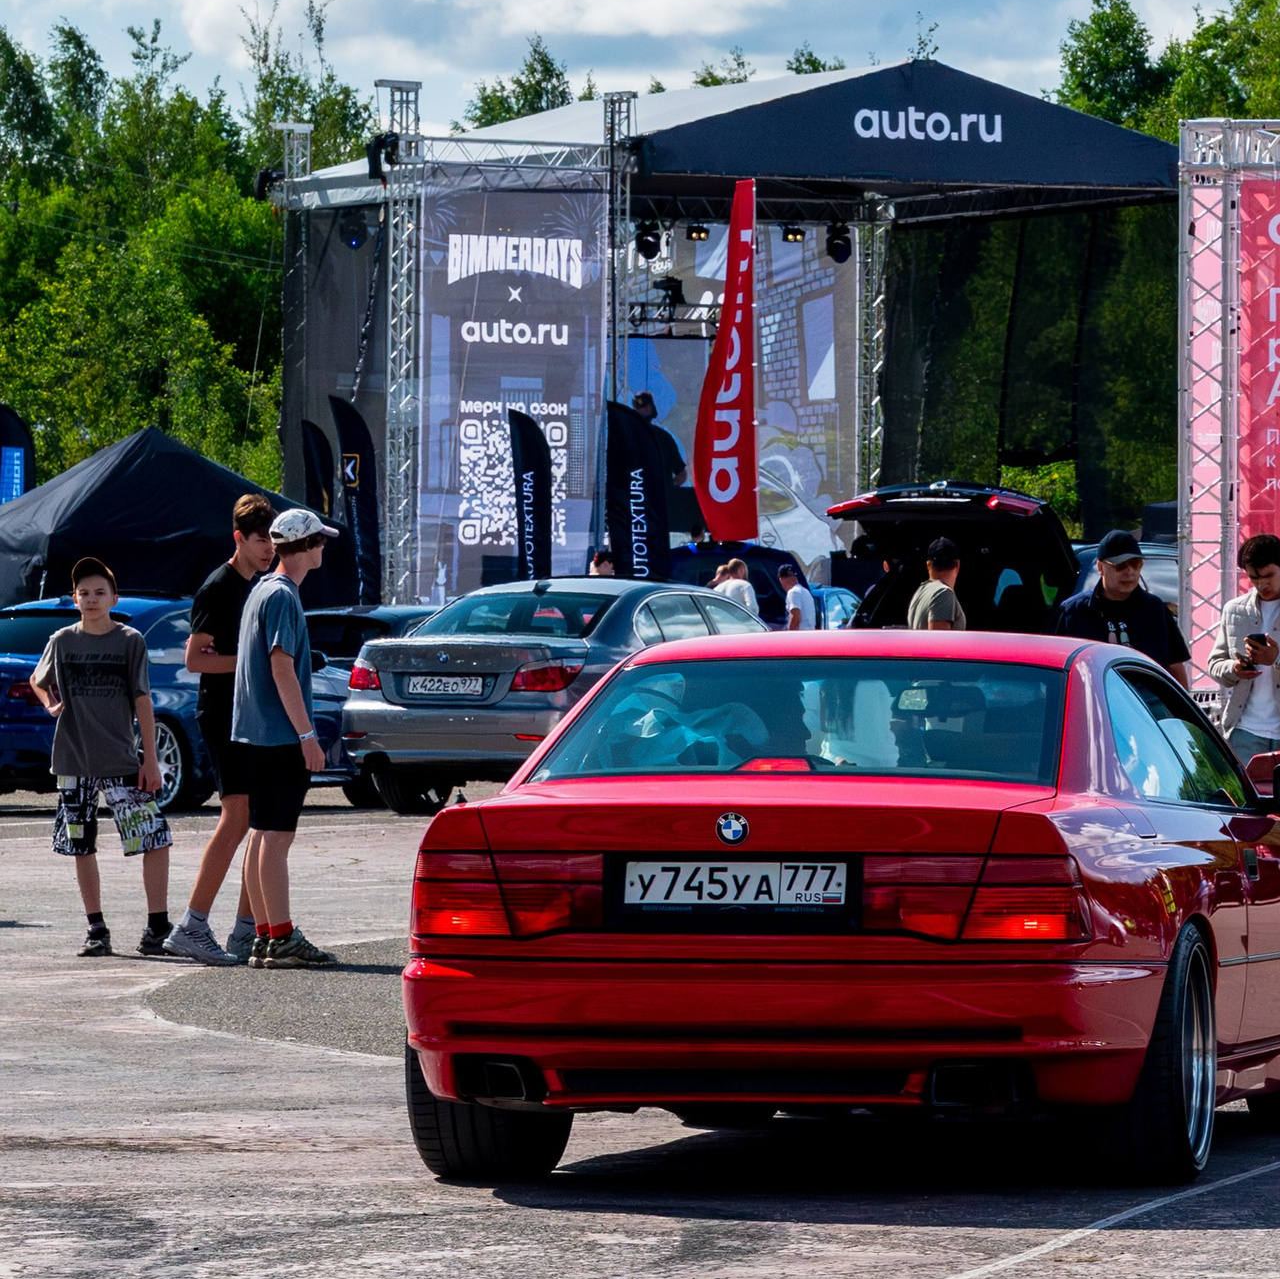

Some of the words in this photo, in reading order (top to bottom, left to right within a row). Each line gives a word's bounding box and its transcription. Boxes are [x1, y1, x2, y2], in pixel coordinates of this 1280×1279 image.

[854, 106, 1002, 143] auto.ru
[448, 234, 583, 290] BIMMERDAYS
[461, 319, 569, 346] auto.ru
[460, 400, 502, 417] мерч
[530, 402, 568, 416] озон
[1266, 455, 1276, 468] к
[630, 468, 650, 578] UTOTEXTURA
[784, 865, 837, 891] 777
[795, 892, 822, 903] RUS
